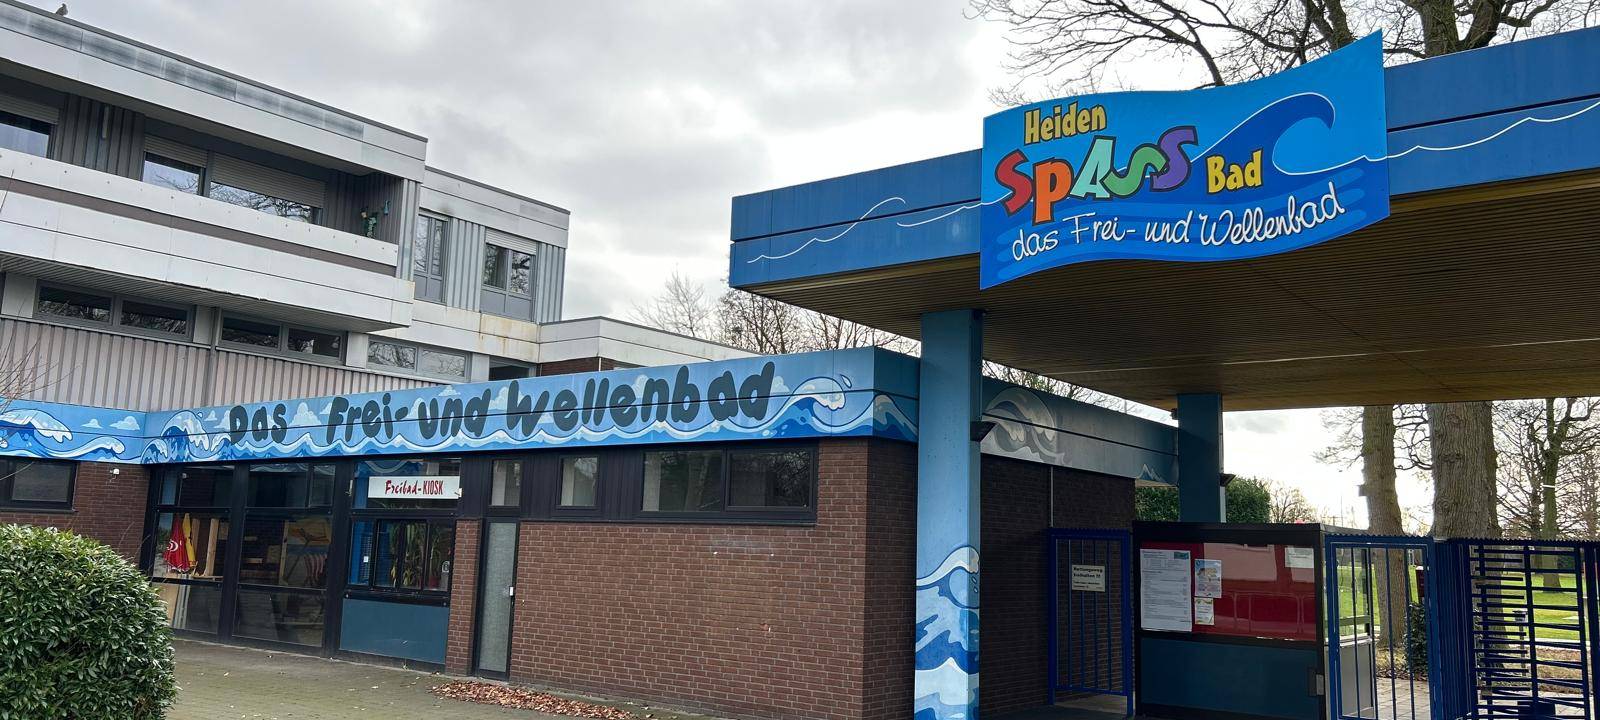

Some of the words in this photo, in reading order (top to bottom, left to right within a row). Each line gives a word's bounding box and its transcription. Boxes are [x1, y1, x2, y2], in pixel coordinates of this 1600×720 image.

[1024, 101, 1107, 146] Heiden
[1205, 146, 1264, 194] Bad
[1012, 229, 1059, 261] das
[1063, 211, 1136, 246] Frei-
[1144, 210, 1193, 244] und
[1199, 181, 1345, 246] Wellenbad
[229, 403, 288, 445] Das
[326, 392, 409, 445] Frei-
[417, 389, 491, 440] und
